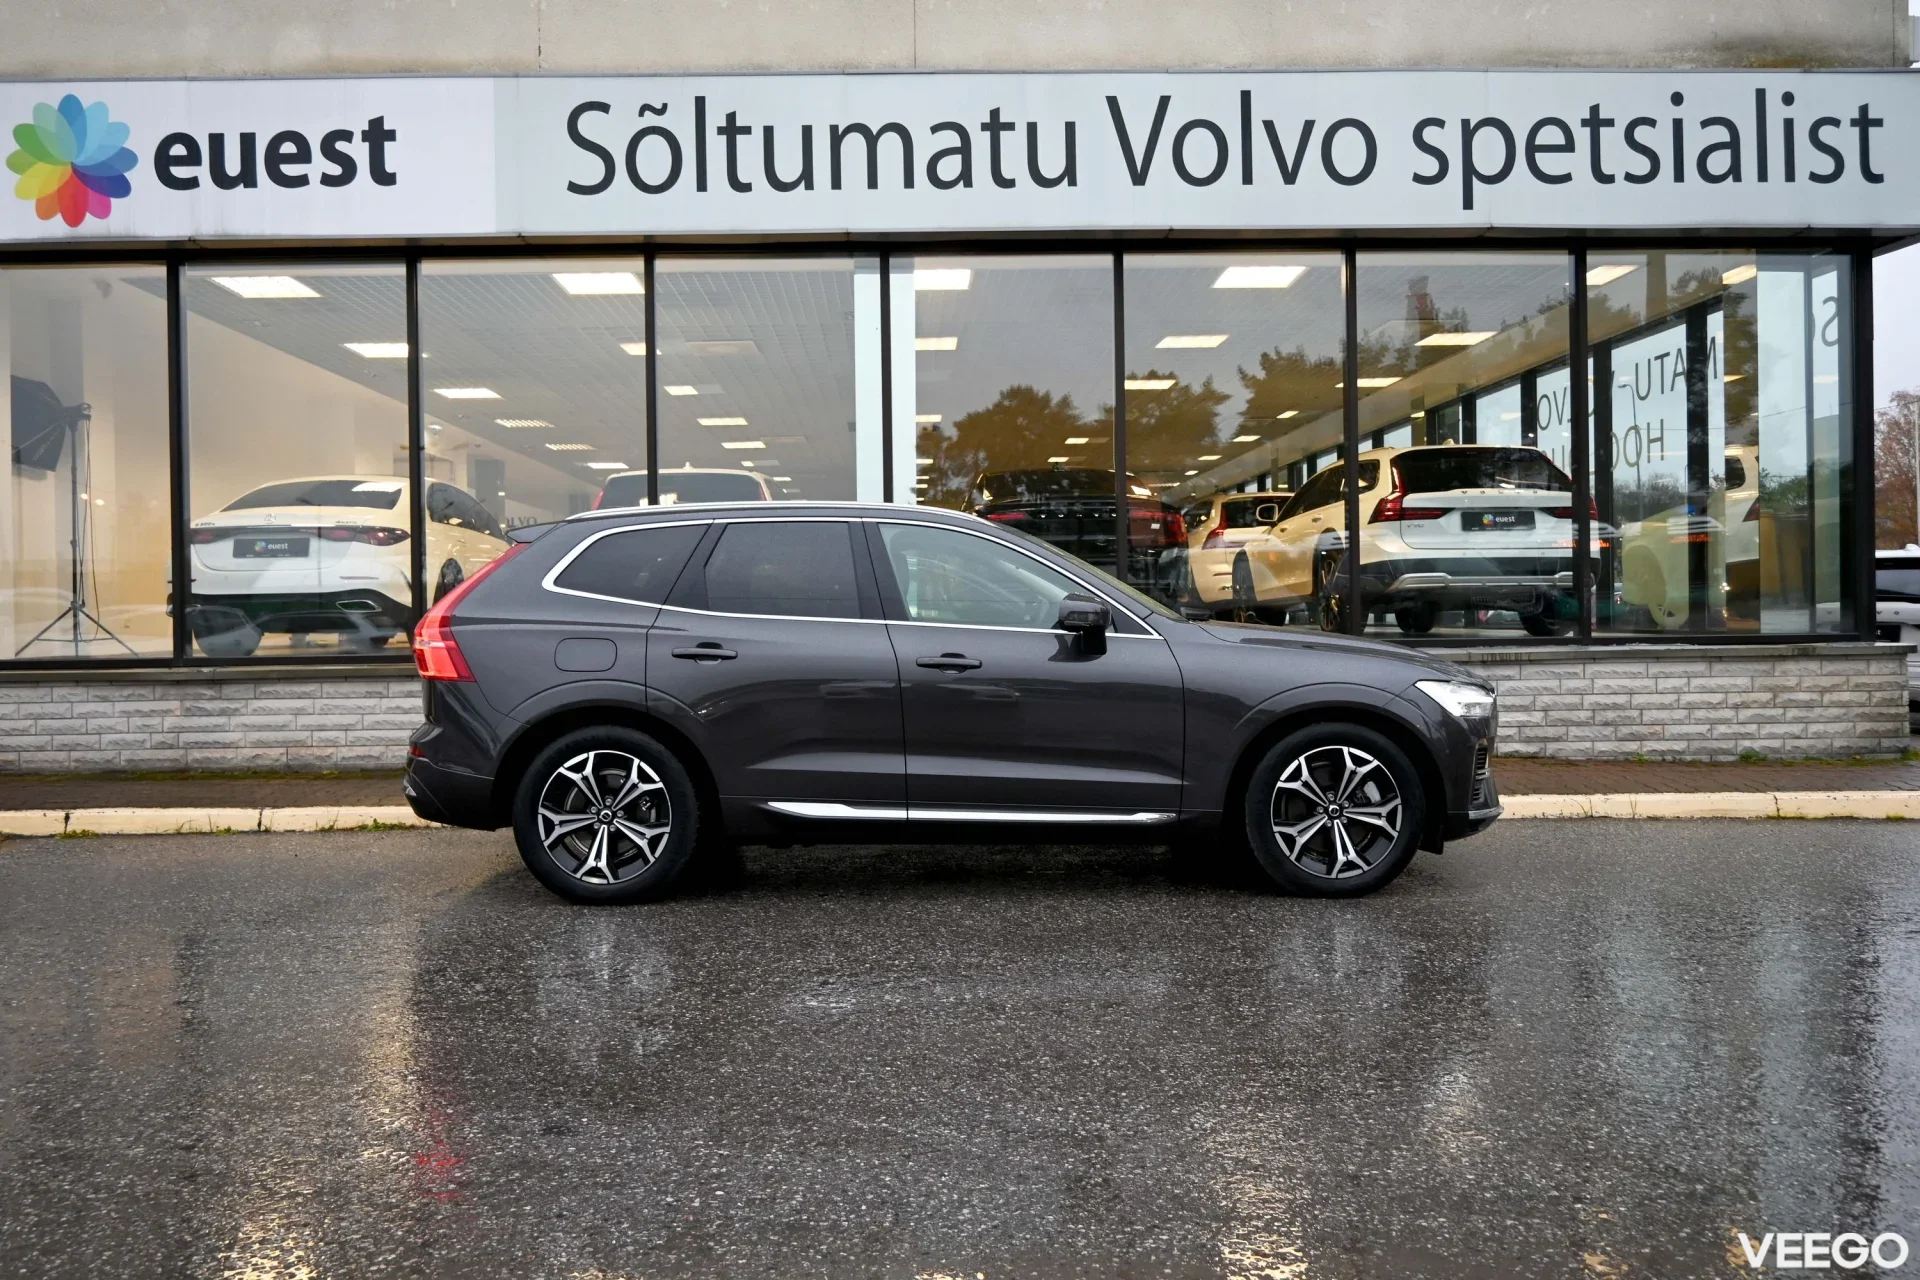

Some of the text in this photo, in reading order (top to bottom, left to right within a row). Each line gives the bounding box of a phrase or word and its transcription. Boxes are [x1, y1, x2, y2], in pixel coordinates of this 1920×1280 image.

[154, 115, 397, 191] euest
[566, 87, 1885, 211] Sõltumatu Volvo spetsialist
[1495, 515, 1516, 523] euest
[267, 542, 289, 550] euest
